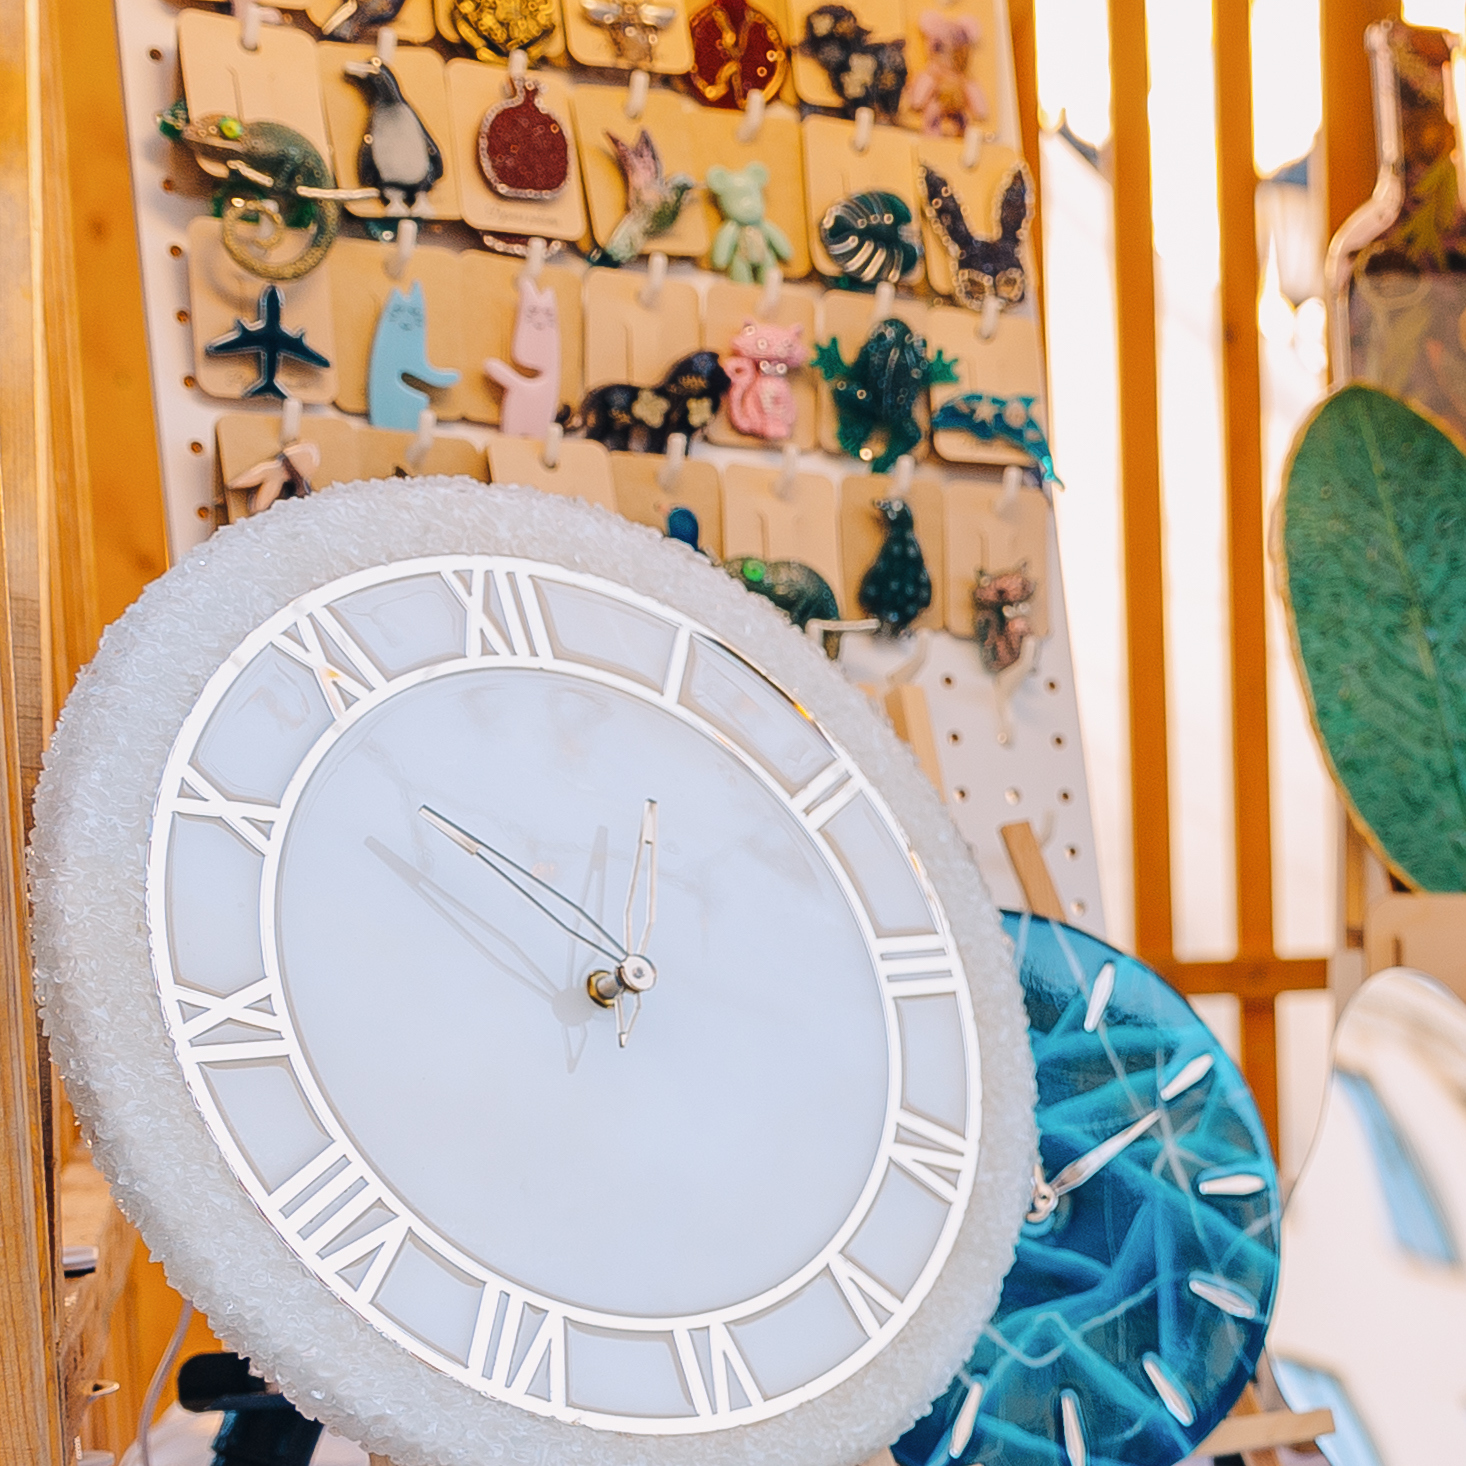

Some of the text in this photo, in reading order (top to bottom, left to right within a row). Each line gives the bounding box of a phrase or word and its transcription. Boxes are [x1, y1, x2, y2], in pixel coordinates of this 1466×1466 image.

[438, 567, 555, 661] XII
[270, 605, 390, 722] XI
[170, 763, 284, 858] X
[789, 757, 865, 833] II
[874, 932, 960, 1000] III
[171, 975, 292, 1065] IX
[888, 1106, 972, 1205] IV
[267, 1139, 412, 1305] VIII
[826, 1250, 904, 1341] V
[466, 1280, 568, 1408] VII
[671, 1321, 767, 1418] VI
